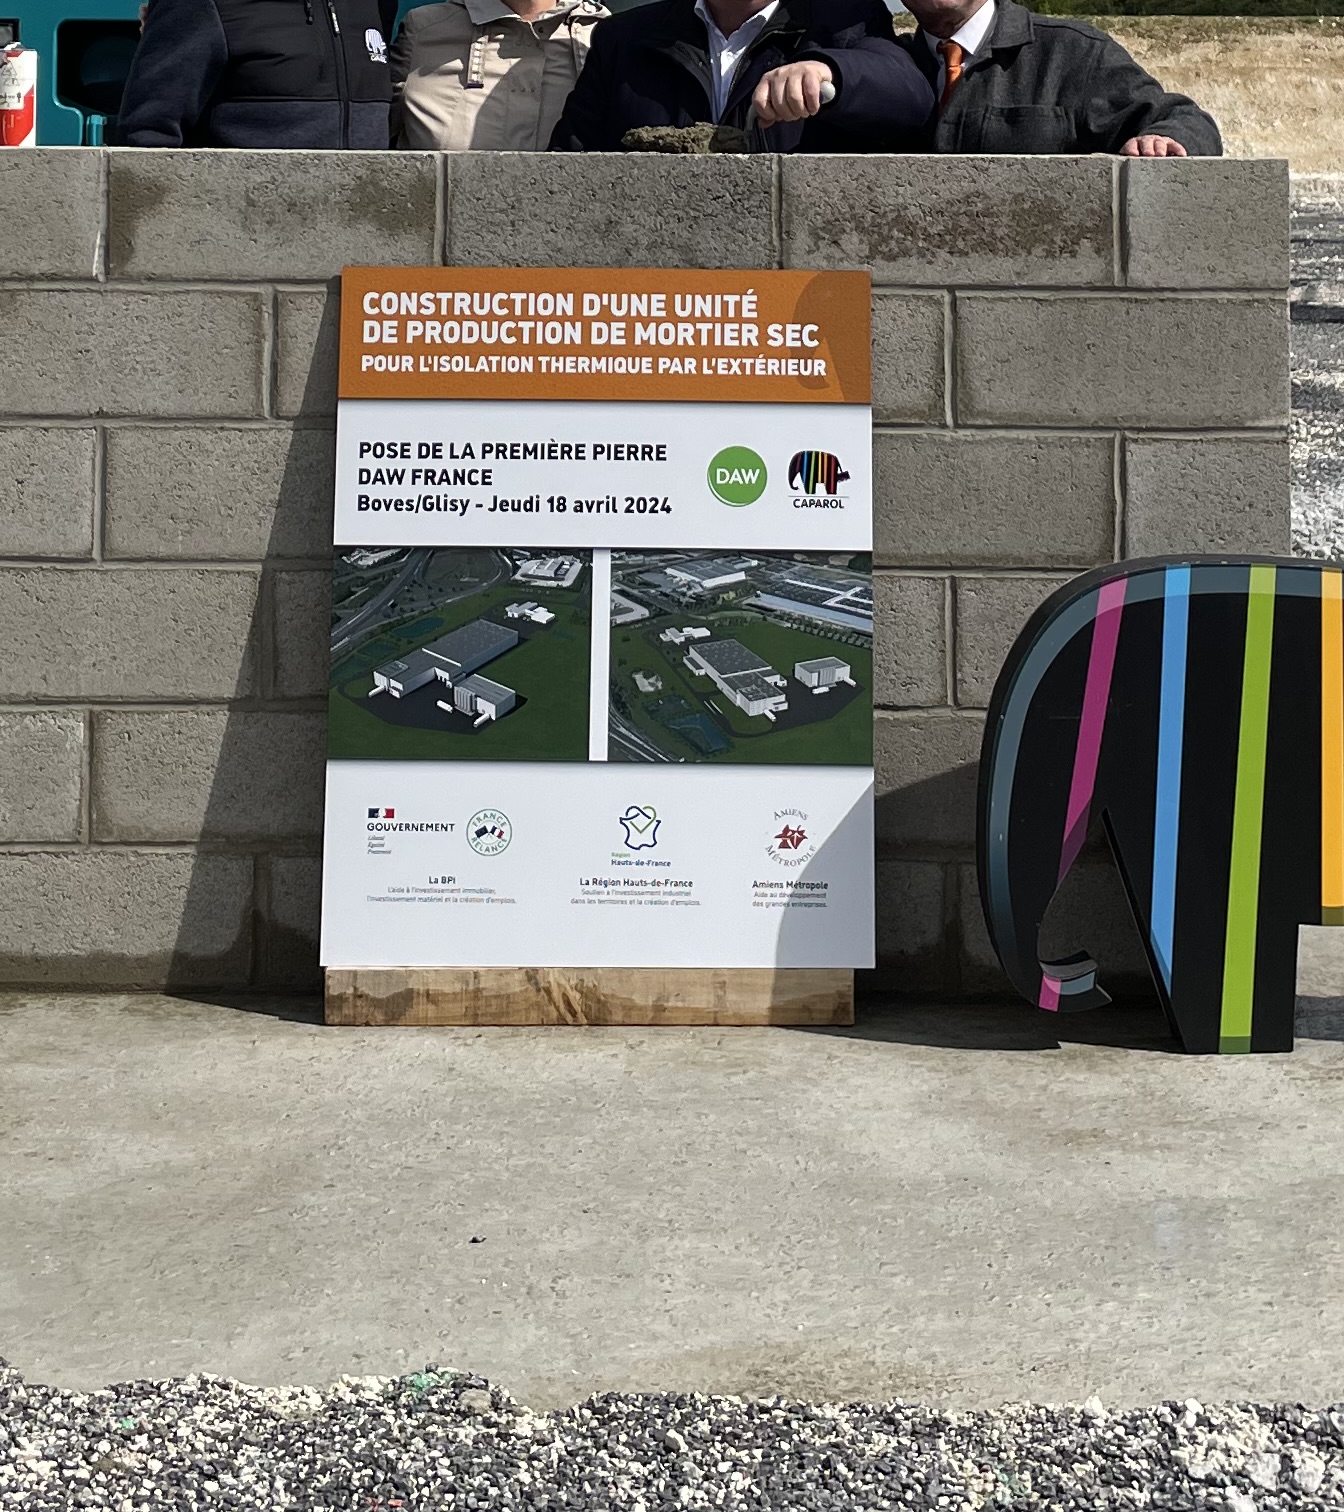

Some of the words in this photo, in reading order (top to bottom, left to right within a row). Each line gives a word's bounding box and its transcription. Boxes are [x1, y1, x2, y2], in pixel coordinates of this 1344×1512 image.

[363, 292, 573, 316] CONSTRUCTION
[583, 294, 666, 316] D'UNE
[675, 289, 757, 317] UNITÉ
[363, 321, 398, 343] DE
[407, 321, 581, 344] PRODUCTION
[591, 322, 626, 344] DE
[635, 322, 758, 346] MORTIER
[767, 324, 819, 347] SEC
[362, 355, 413, 371] POUR
[420, 356, 533, 372] L'ISOLATION
[538, 357, 652, 373] THERMIQUE
[659, 358, 696, 374] PAR
[703, 354, 826, 375] L'EXTÉRIEUR
[360, 442, 411, 459] POSE
[418, 443, 443, 459] DE
[450, 443, 475, 459] LA
[482, 438, 585, 460] PREMIÈRE
[593, 444, 666, 461] PIERRE
[359, 468, 405, 485] DAW
[412, 469, 492, 485] FRANCE
[715, 467, 761, 486] DAW
[358, 494, 470, 516] Boves/Glisy
[488, 495, 539, 512] Jeudi
[547, 496, 566, 512] 18
[573, 495, 617, 513] avril
[624, 497, 672, 513] 2024
[793, 499, 844, 508] CAPAROL
[472, 812, 507, 827] FRANCE
[773, 808, 809, 821] AMIENS
[367, 822, 456, 832] GOUVERNEMENT
[471, 837, 507, 854] RELANCE
[765, 844, 816, 867] MÉTROPOLE
[429, 876, 438, 884] La
[579, 877, 590, 886] La
[592, 877, 622, 888] Région
[623, 878, 694, 887] Hauts-de-France
[752, 880, 784, 889] Amiens
[786, 879, 829, 891] Métropole
